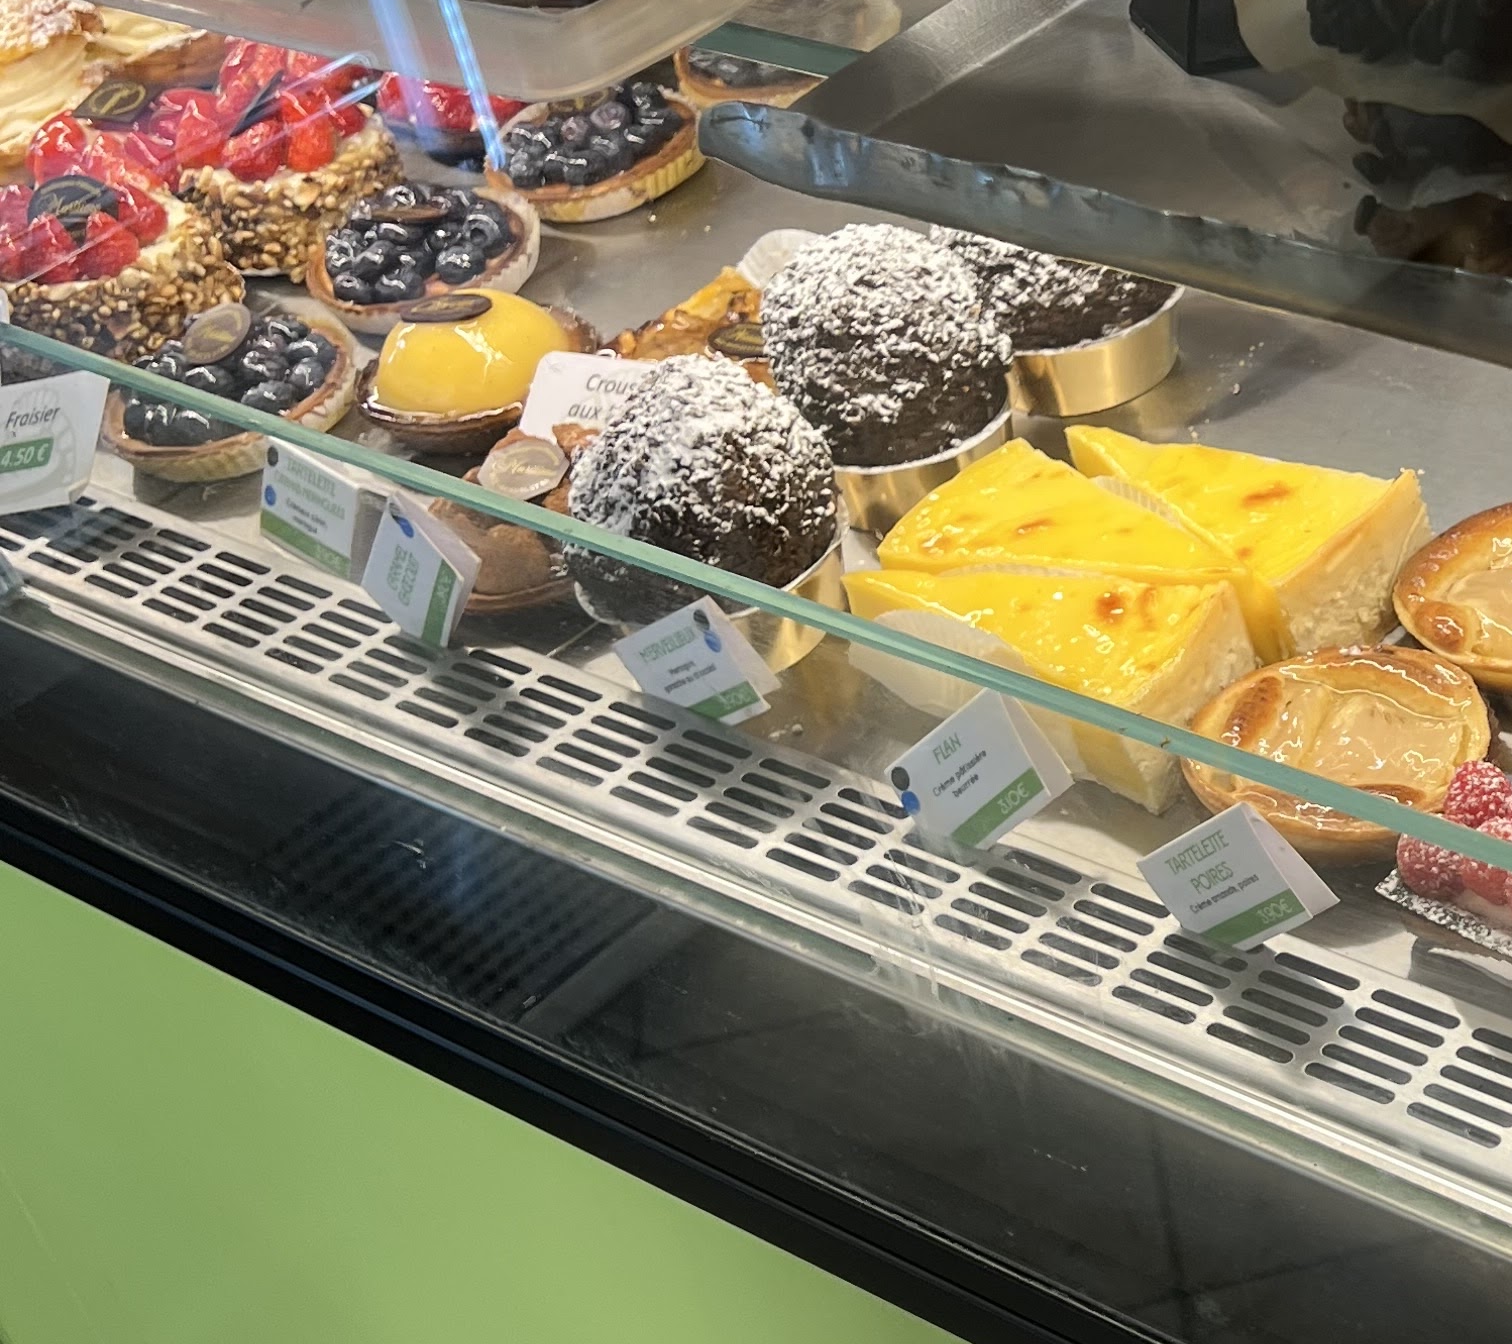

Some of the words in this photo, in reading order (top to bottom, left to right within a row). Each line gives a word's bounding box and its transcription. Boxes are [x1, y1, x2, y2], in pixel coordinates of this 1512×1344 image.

[5, 405, 61, 430] Fraisier
[568, 403, 602, 420] aux
[1, 446, 35, 467] 4.50
[932, 733, 962, 764] FLAN
[1164, 829, 1230, 875] TARTELETTE
[1190, 861, 1234, 894] POIRES
